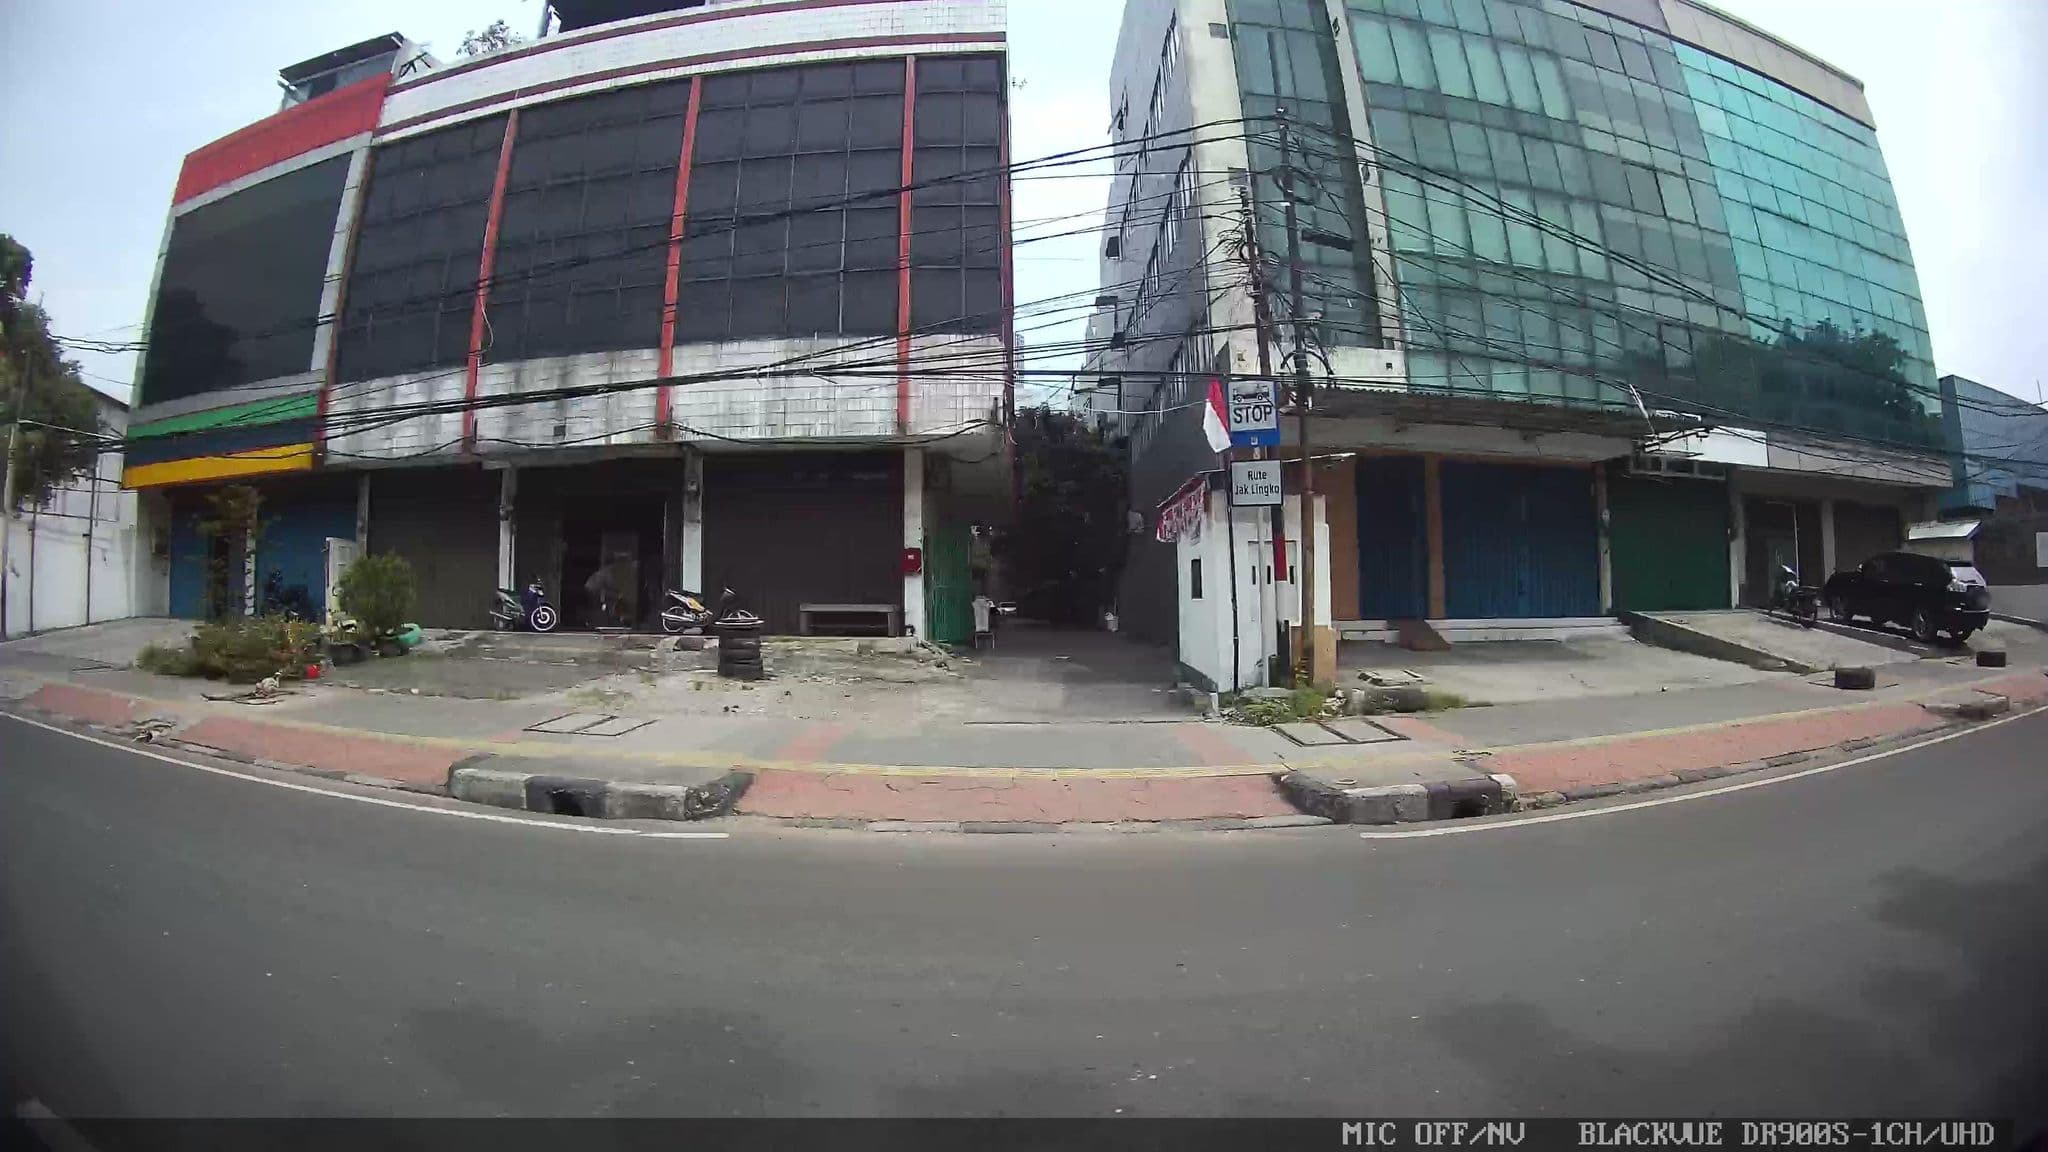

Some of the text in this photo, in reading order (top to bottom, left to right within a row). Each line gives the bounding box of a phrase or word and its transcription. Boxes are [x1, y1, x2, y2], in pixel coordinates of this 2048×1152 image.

[1233, 405, 1272, 424] STOP
[1248, 470, 1267, 481] Rute
[1235, 483, 1280, 497] Jak Lingko
